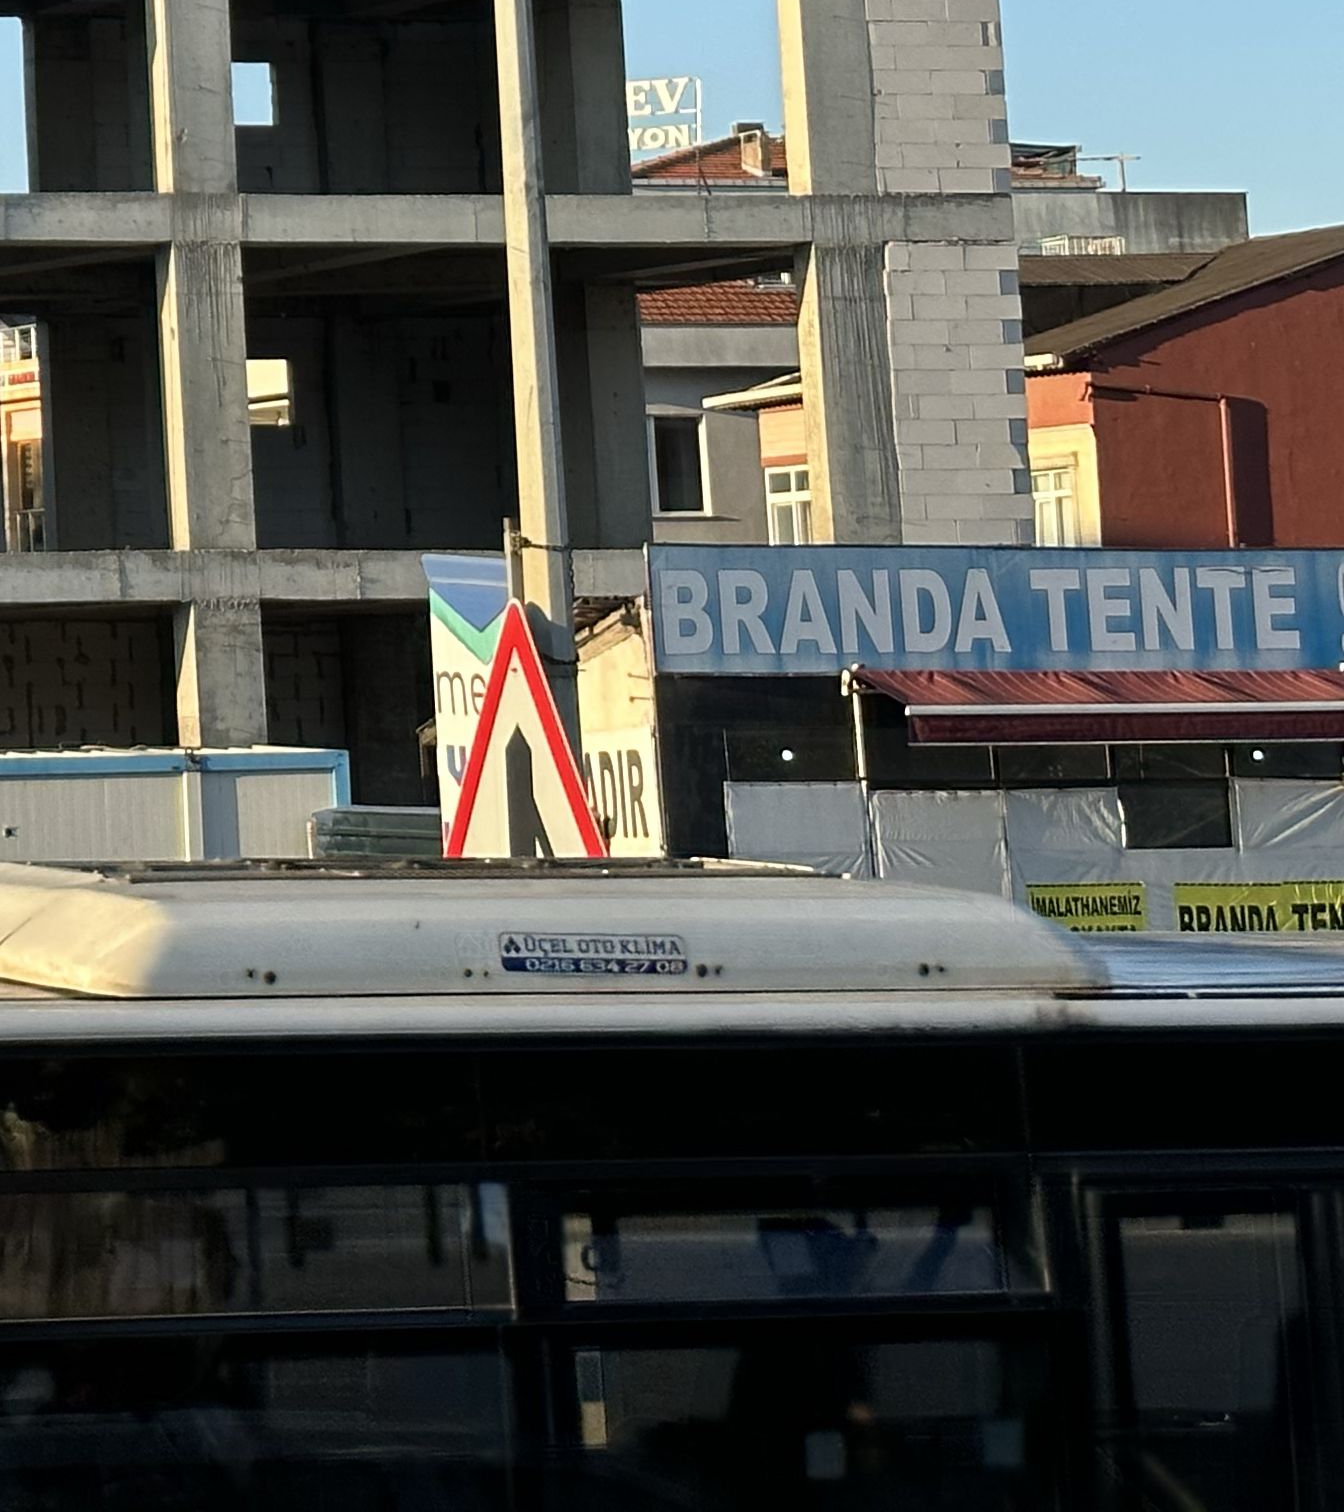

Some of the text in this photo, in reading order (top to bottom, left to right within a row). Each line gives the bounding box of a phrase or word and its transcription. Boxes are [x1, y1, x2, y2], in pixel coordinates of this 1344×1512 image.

[660, 568, 1012, 656] BRANDA
[1029, 565, 1301, 653] TENTE
[1029, 890, 1142, 918] İMALATHANEMİZ
[1178, 904, 1279, 932] BRANDA
[523, 935, 681, 956] ÜÇEL OTO KLİMA
[525, 958, 576, 971] 0216
[625, 960, 649, 973] 27
[656, 960, 684, 973] 08
